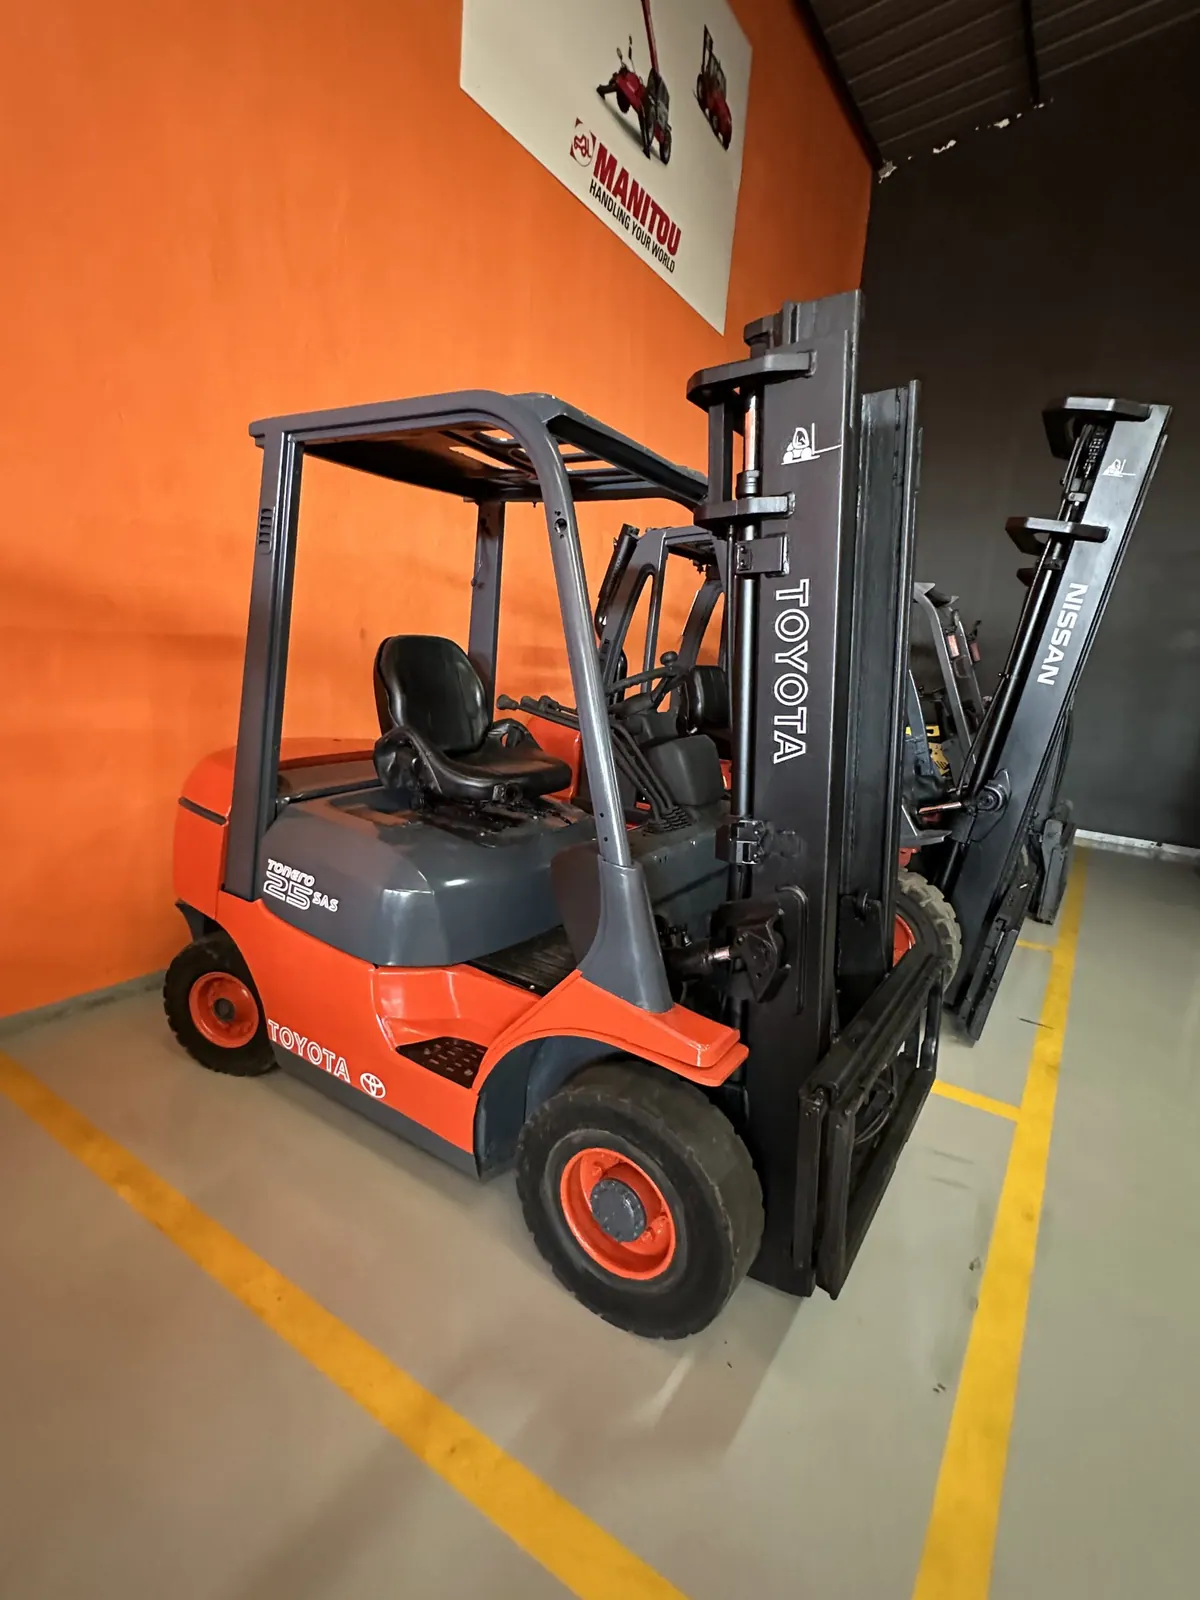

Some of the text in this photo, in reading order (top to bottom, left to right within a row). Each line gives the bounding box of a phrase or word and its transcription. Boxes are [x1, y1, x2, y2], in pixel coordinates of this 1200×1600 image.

[589, 179, 676, 274] HANDLING YOUR WORLD
[593, 142, 682, 256] MANITOU
[773, 578, 810, 764] TOYOTA
[1036, 582, 1089, 686] NISSAN
[263, 870, 339, 912] 25 SAS
[267, 1018, 352, 1084] TOYOTA
